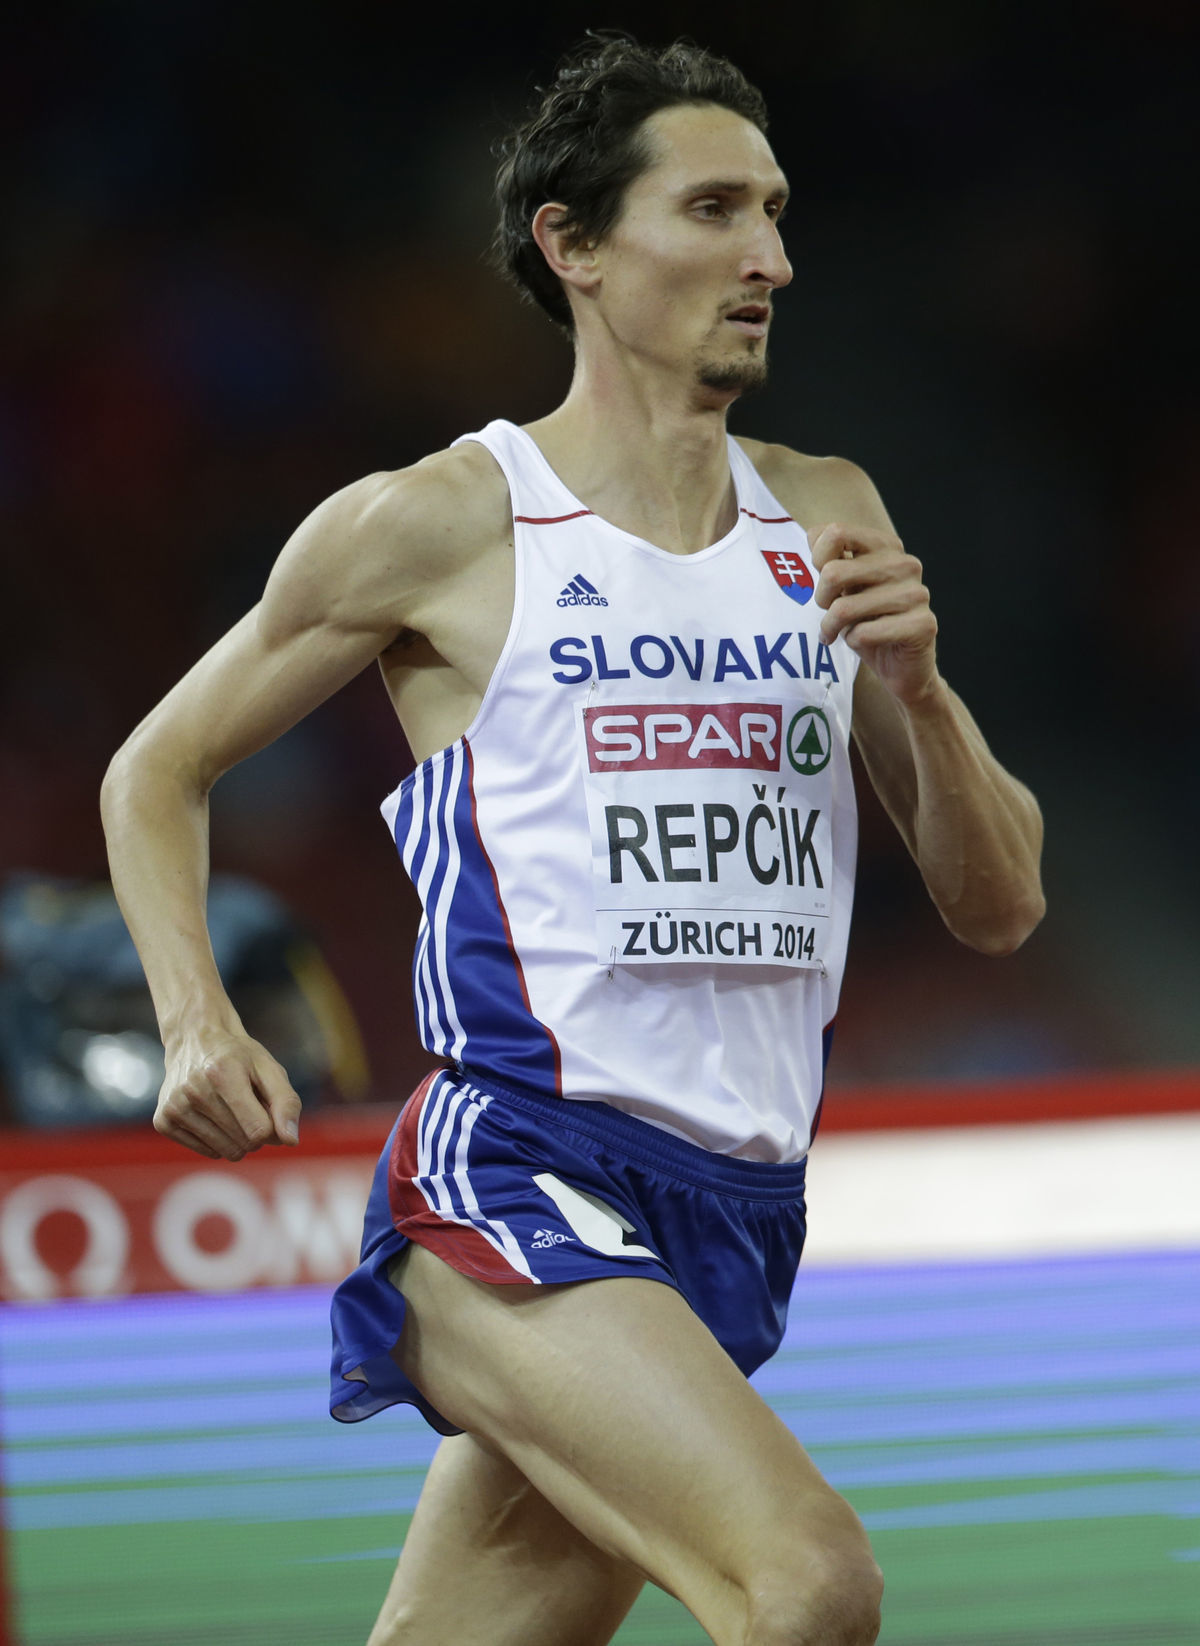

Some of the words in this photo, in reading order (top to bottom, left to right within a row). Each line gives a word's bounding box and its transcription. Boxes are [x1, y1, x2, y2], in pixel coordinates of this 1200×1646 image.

[556, 594, 609, 608] adidas
[549, 632, 840, 684] SLOVAKIA
[591, 713, 777, 762] SPAR
[604, 783, 824, 889] REPČÍK
[621, 911, 763, 956] ZÜRICH
[771, 922, 816, 961] 2014
